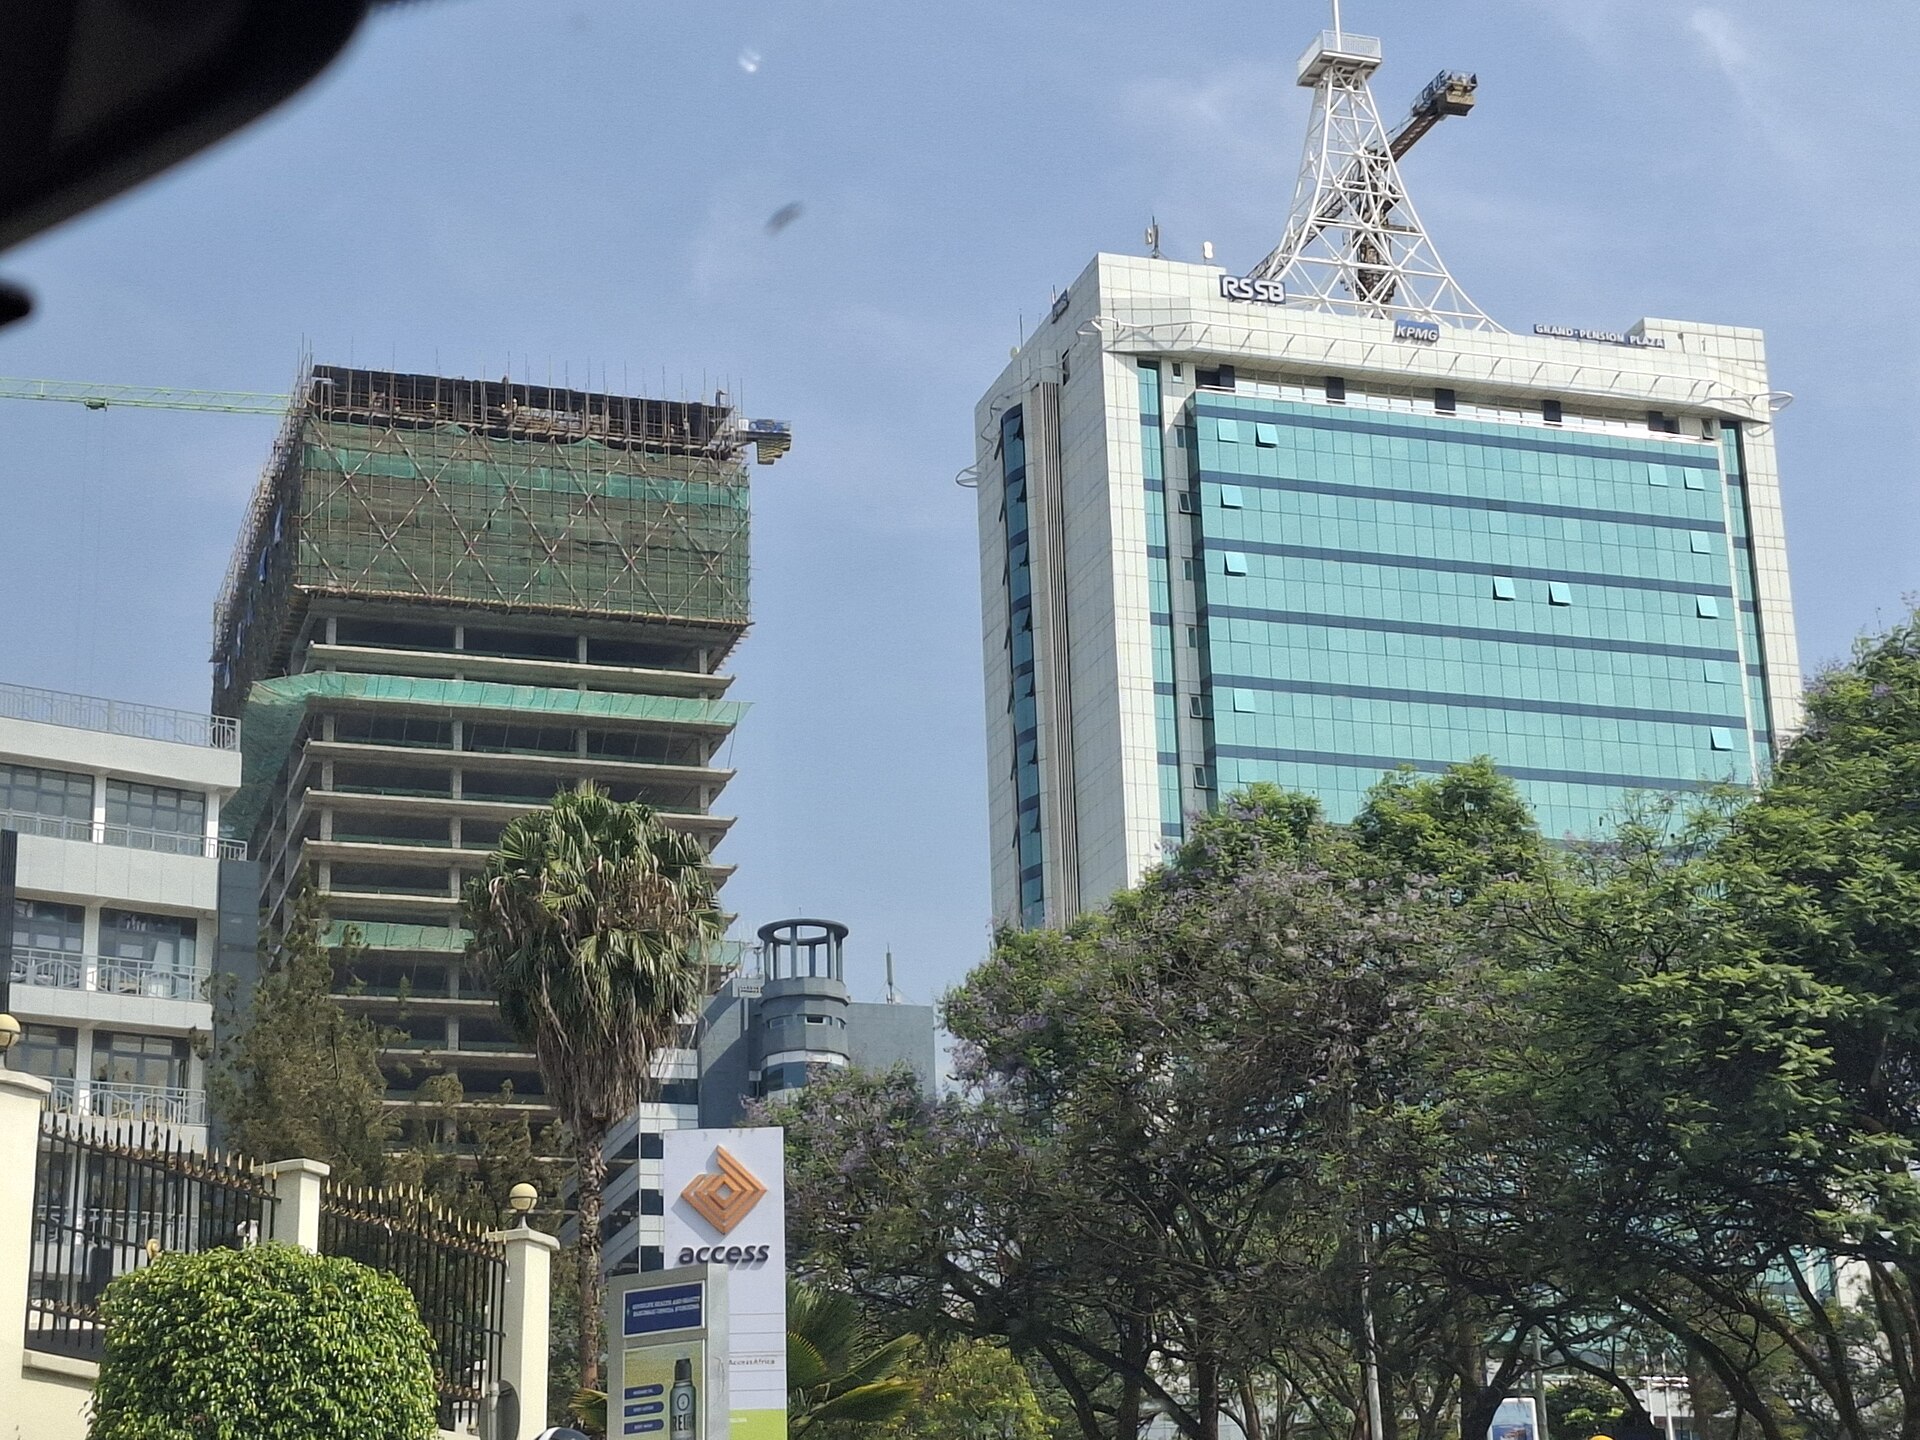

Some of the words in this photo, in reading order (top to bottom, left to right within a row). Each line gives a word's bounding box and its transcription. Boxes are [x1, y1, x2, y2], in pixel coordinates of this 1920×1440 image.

[1222, 276, 1285, 302] RSSB
[1396, 325, 1438, 341] KPMG
[1535, 324, 1574, 337] GRAND
[1579, 329, 1625, 342] PENSION
[1629, 335, 1664, 347] PLAZA
[679, 1245, 770, 1264] access
